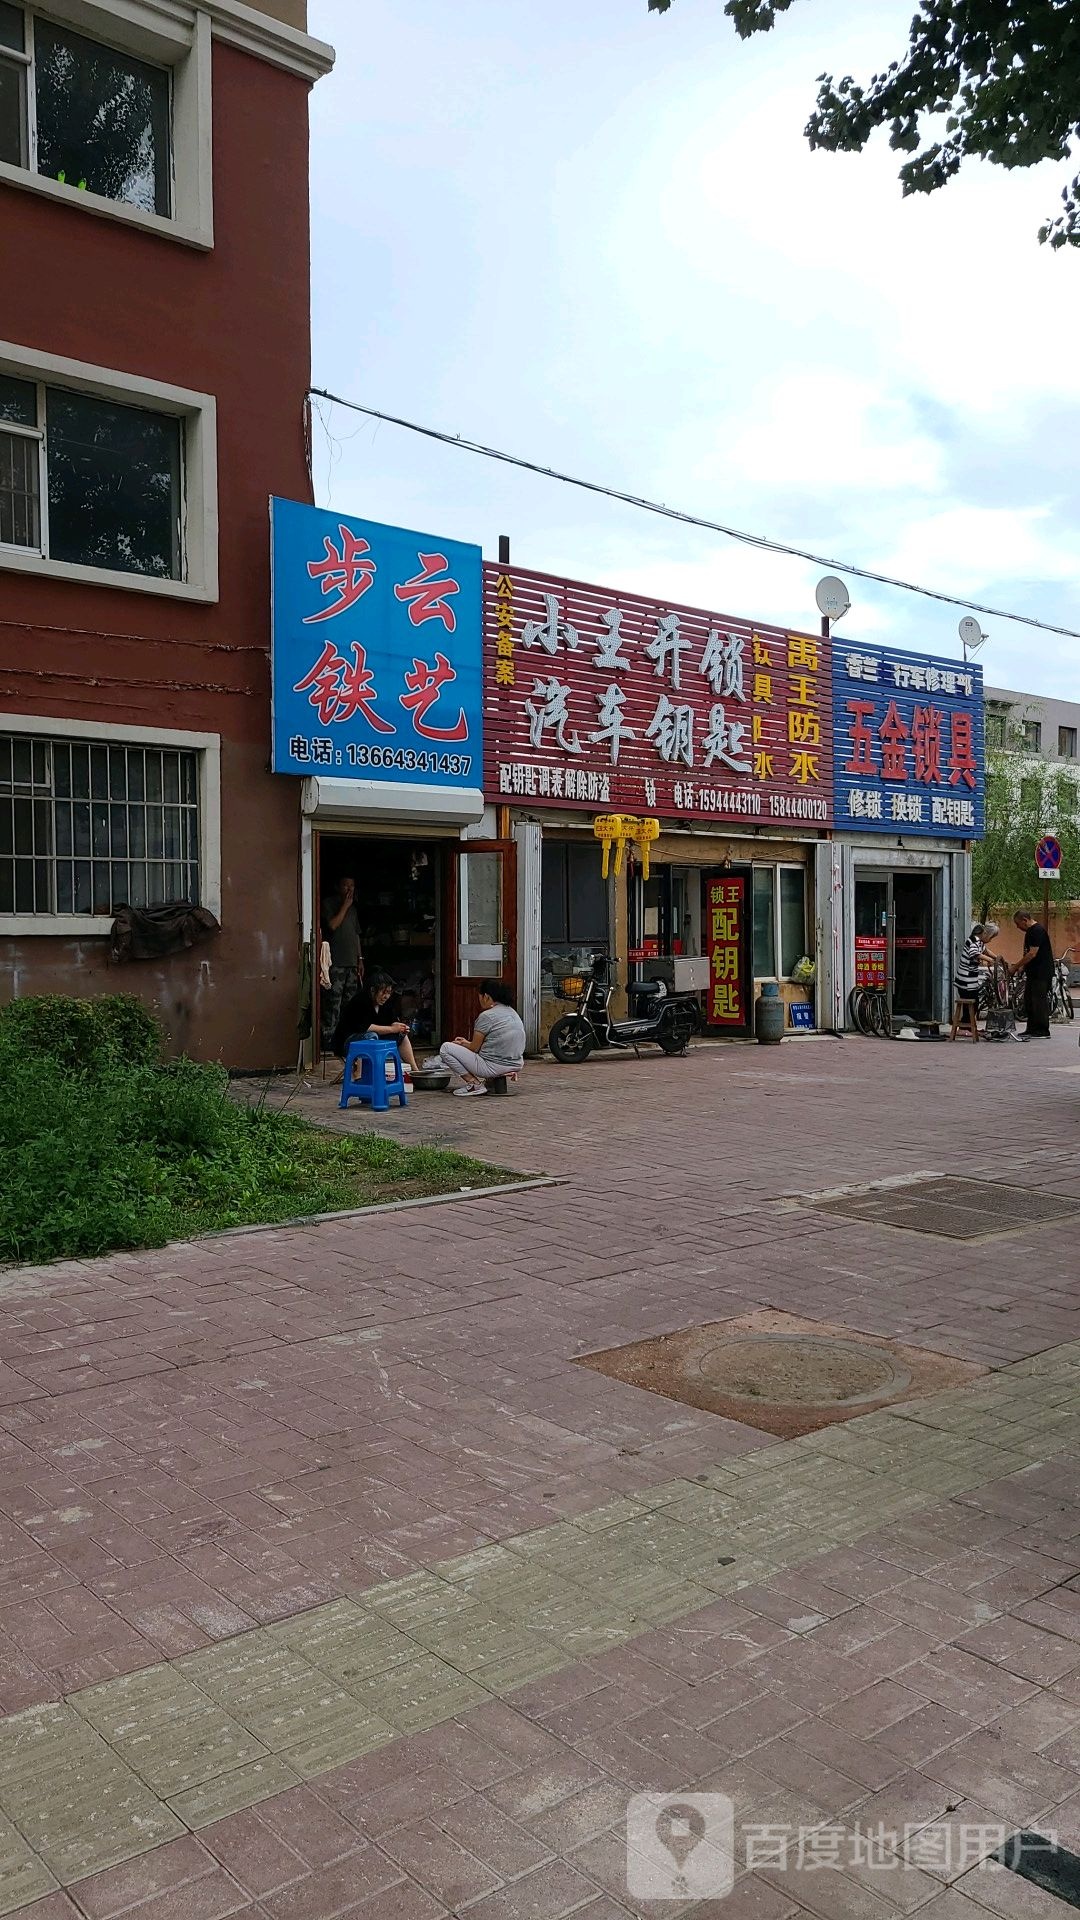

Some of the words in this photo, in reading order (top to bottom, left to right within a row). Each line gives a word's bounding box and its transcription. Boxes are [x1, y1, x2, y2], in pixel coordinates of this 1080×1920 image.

[302, 524, 459, 632] 步云
[495, 575, 515, 686] 公安备案
[522, 593, 746, 702] 小王开锁
[293, 640, 468, 742] 铁艺
[525, 676, 752, 772] 汽车钥匙
[787, 635, 820, 784] 禹王防水
[845, 700, 977, 789] 五金锁具
[769, 795, 827, 821] 15844400120
[848, 789, 883, 819] 修锁
[891, 793, 922, 822] 换锁
[931, 797, 975, 827] 配钥匙
[710, 885, 740, 904] 锁王
[711, 907, 740, 1019] 配钥匙
